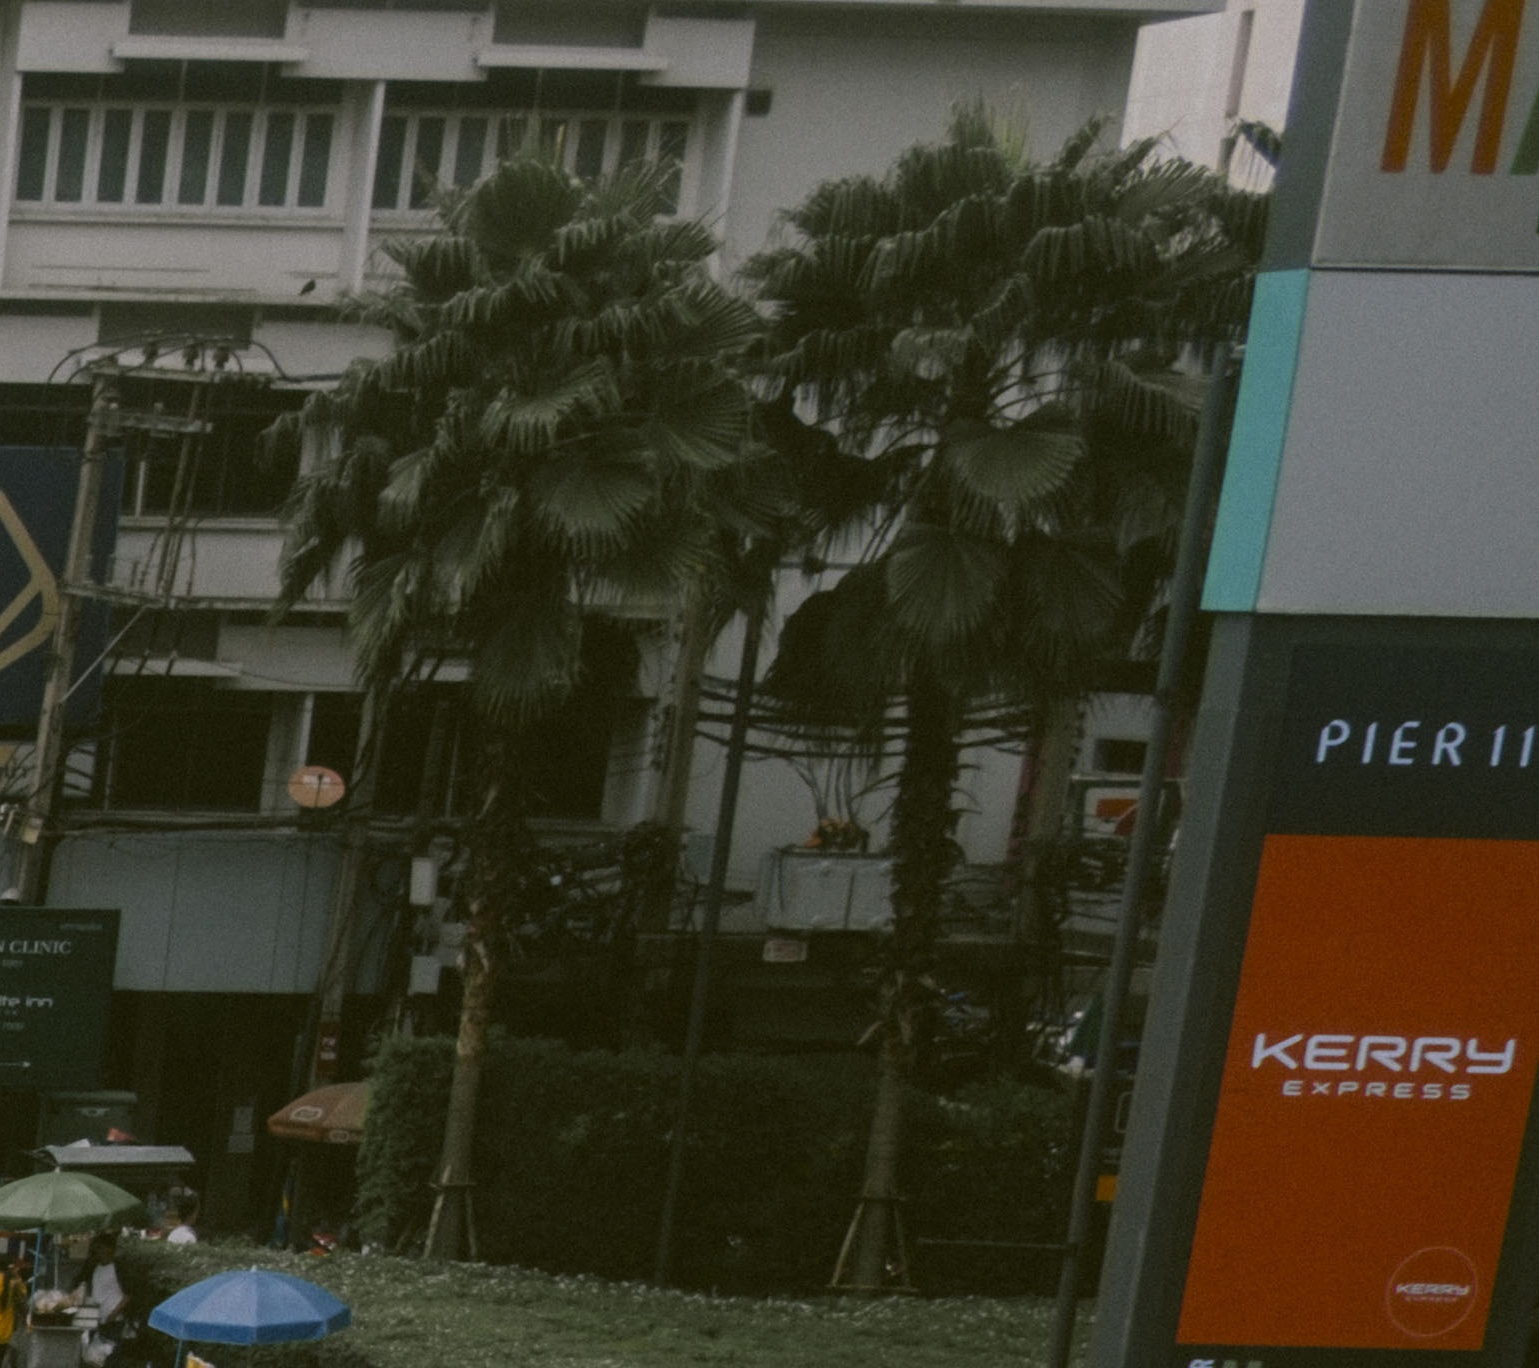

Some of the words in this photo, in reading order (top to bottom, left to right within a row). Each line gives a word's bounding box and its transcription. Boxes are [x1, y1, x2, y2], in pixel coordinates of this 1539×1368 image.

[1381, 0, 1539, 176] M
[1317, 718, 1466, 768] PIER
[9, 939, 72, 955] CLINIC
[1251, 1033, 1516, 1074] KERRY
[1282, 1080, 1471, 1100] EXPRESS
[1395, 1283, 1470, 1296] KERRY
